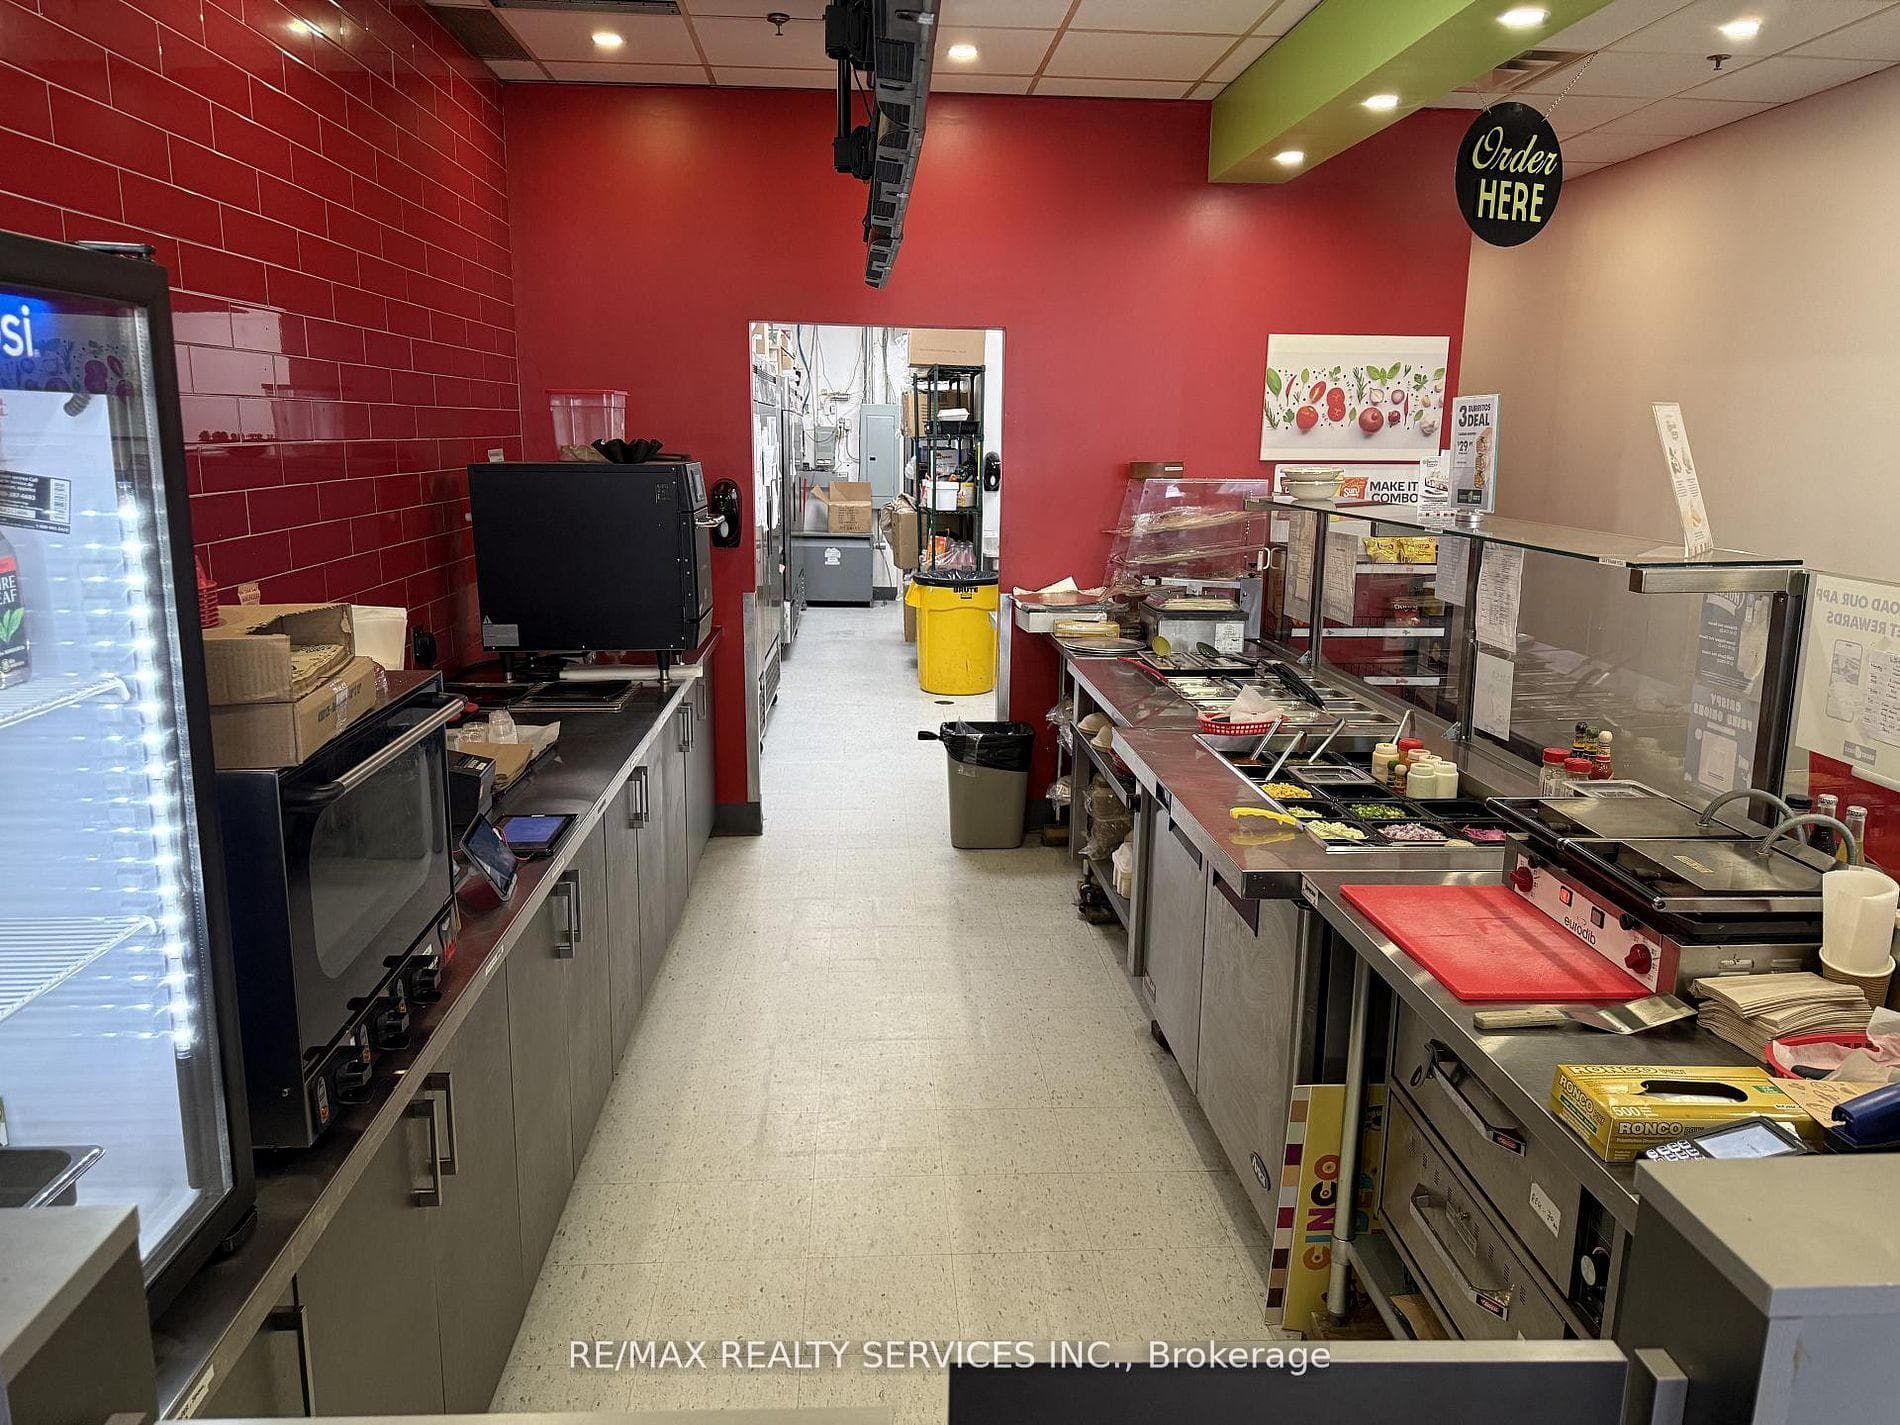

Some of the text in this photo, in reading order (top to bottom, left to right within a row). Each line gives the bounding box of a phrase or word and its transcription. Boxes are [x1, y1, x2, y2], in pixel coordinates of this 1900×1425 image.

[1472, 126, 1558, 176] Order
[1477, 178, 1545, 223] HERE
[1458, 405, 1467, 427] 3
[1467, 413, 1490, 427] DEAL
[1369, 481, 1419, 492] MAKE IT
[1371, 493, 1418, 504] COMBO
[1564, 915, 1596, 945] eurodib
[1568, 1065, 1658, 1075] RONCO
[1559, 1074, 1594, 1113] RONCO
[1612, 1106, 1641, 1117] 500
[1618, 1121, 1683, 1136] RONCO
[1303, 1154, 1341, 1271] CINCO
